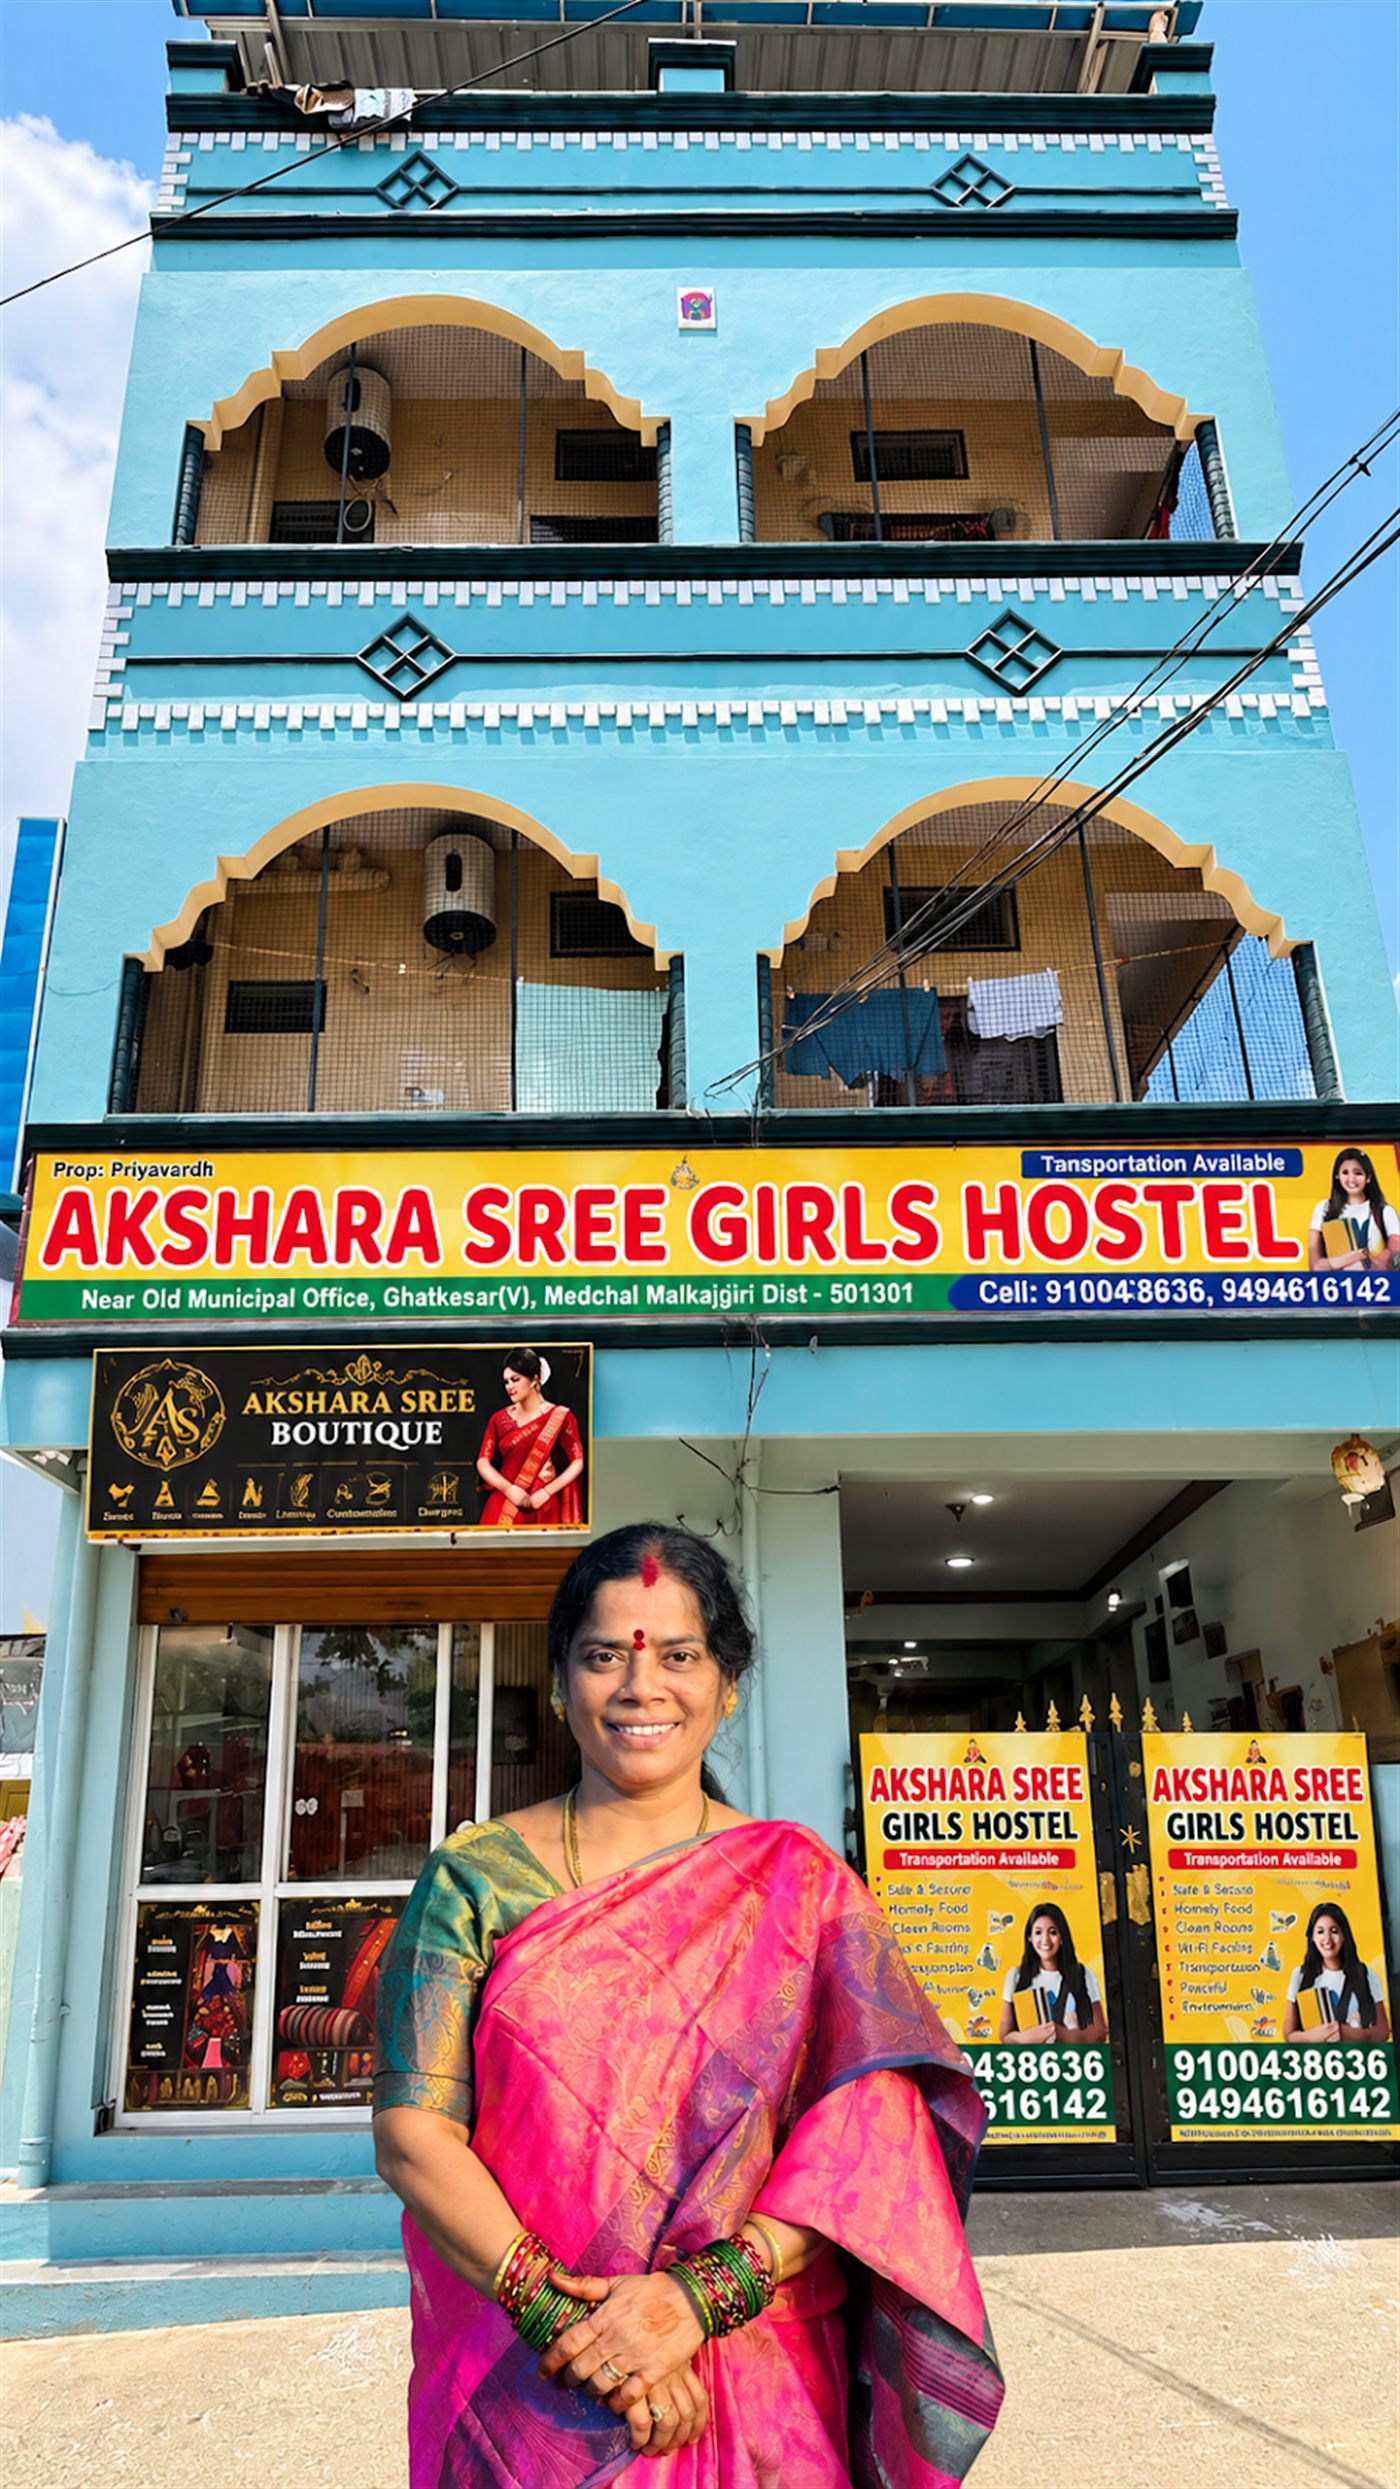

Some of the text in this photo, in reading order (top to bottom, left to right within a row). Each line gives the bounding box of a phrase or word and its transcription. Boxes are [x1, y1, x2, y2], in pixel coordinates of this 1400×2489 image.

[53, 1159, 214, 1182] Prop: Priyavardh
[1193, 1152, 1286, 1173] Available
[42, 1183, 1300, 1266] AKSHARA SREE GIRLS HOSTEL
[81, 1289, 135, 1309] Near
[142, 1288, 181, 1309] Old
[188, 1287, 296, 1312] Municipal
[302, 1287, 375, 1311] Office,
[383, 1285, 537, 1311] Ghatkesar(V),
[544, 1284, 639, 1306] Medchal
[762, 1283, 808, 1304] Dist
[830, 1282, 913, 1304] 501301
[979, 1276, 1391, 1308] Cell: 910048636, 9494616142
[241, 1389, 476, 1415] AKSHARA SREE
[271, 1421, 443, 1450] BOUTIQUE
[870, 1767, 1083, 1802] AKSHARA SREE
[1153, 1768, 1364, 1802] AKSHARA SREE
[882, 1811, 1078, 1841] GIRLS HOSTEL
[1167, 1811, 1359, 1841] GIRLS HOSTEL
[899, 1852, 1060, 1868] Transportation Available
[1184, 1852, 1342, 1869] Transportation Available
[938, 1902, 968, 1914] Food
[1173, 2049, 1389, 2083] 9100438636
[1176, 2086, 1392, 2120] 9494616142
